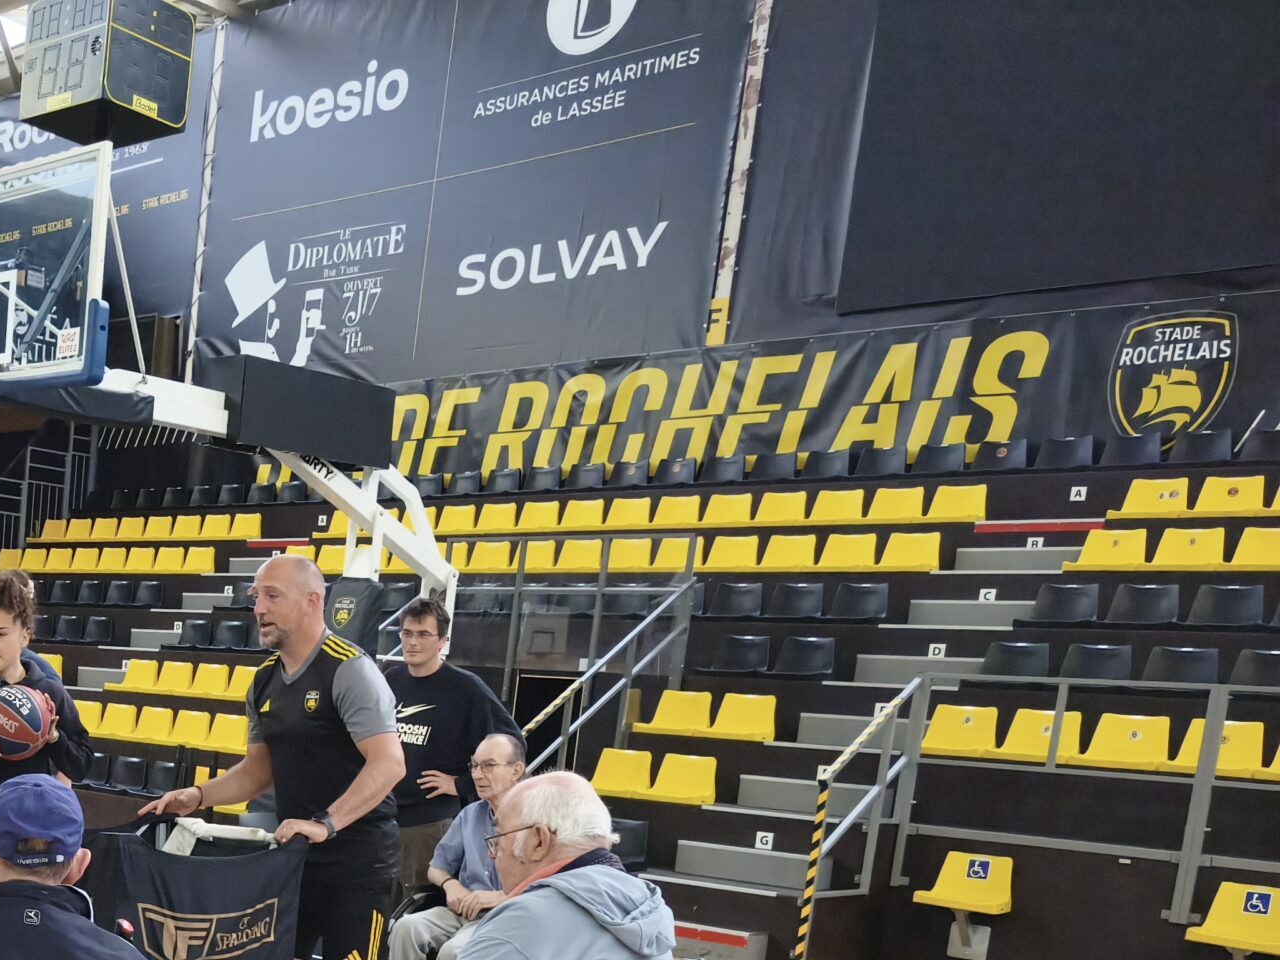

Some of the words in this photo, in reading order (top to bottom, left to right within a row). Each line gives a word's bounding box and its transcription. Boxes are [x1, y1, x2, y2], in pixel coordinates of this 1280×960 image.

[473, 75, 590, 119] ASSURANCES
[594, 48, 701, 86] MARITIMES
[134, 98, 158, 115] Bodet
[250, 59, 410, 143] koesio
[530, 108, 552, 128] de
[557, 90, 626, 123] LASSÉE
[123, 141, 149, 159] 1968
[340, 228, 352, 240] LE
[287, 223, 407, 272] DIPLOMATE
[455, 221, 669, 296] SOLVAY
[344, 277, 383, 291] OUVERT
[1154, 325, 1202, 343] STADE
[1119, 339, 1232, 367] ROCHELAIS
[481, 330, 1050, 487] ROCHELAIS
[1073, 488, 1083, 499] A
[1031, 539, 1039, 549] B
[983, 591, 992, 601] C
[932, 646, 942, 657] D
[397, 722, 428, 735] OOSH
[399, 733, 426, 745] NIKE
[760, 835, 769, 846] G
